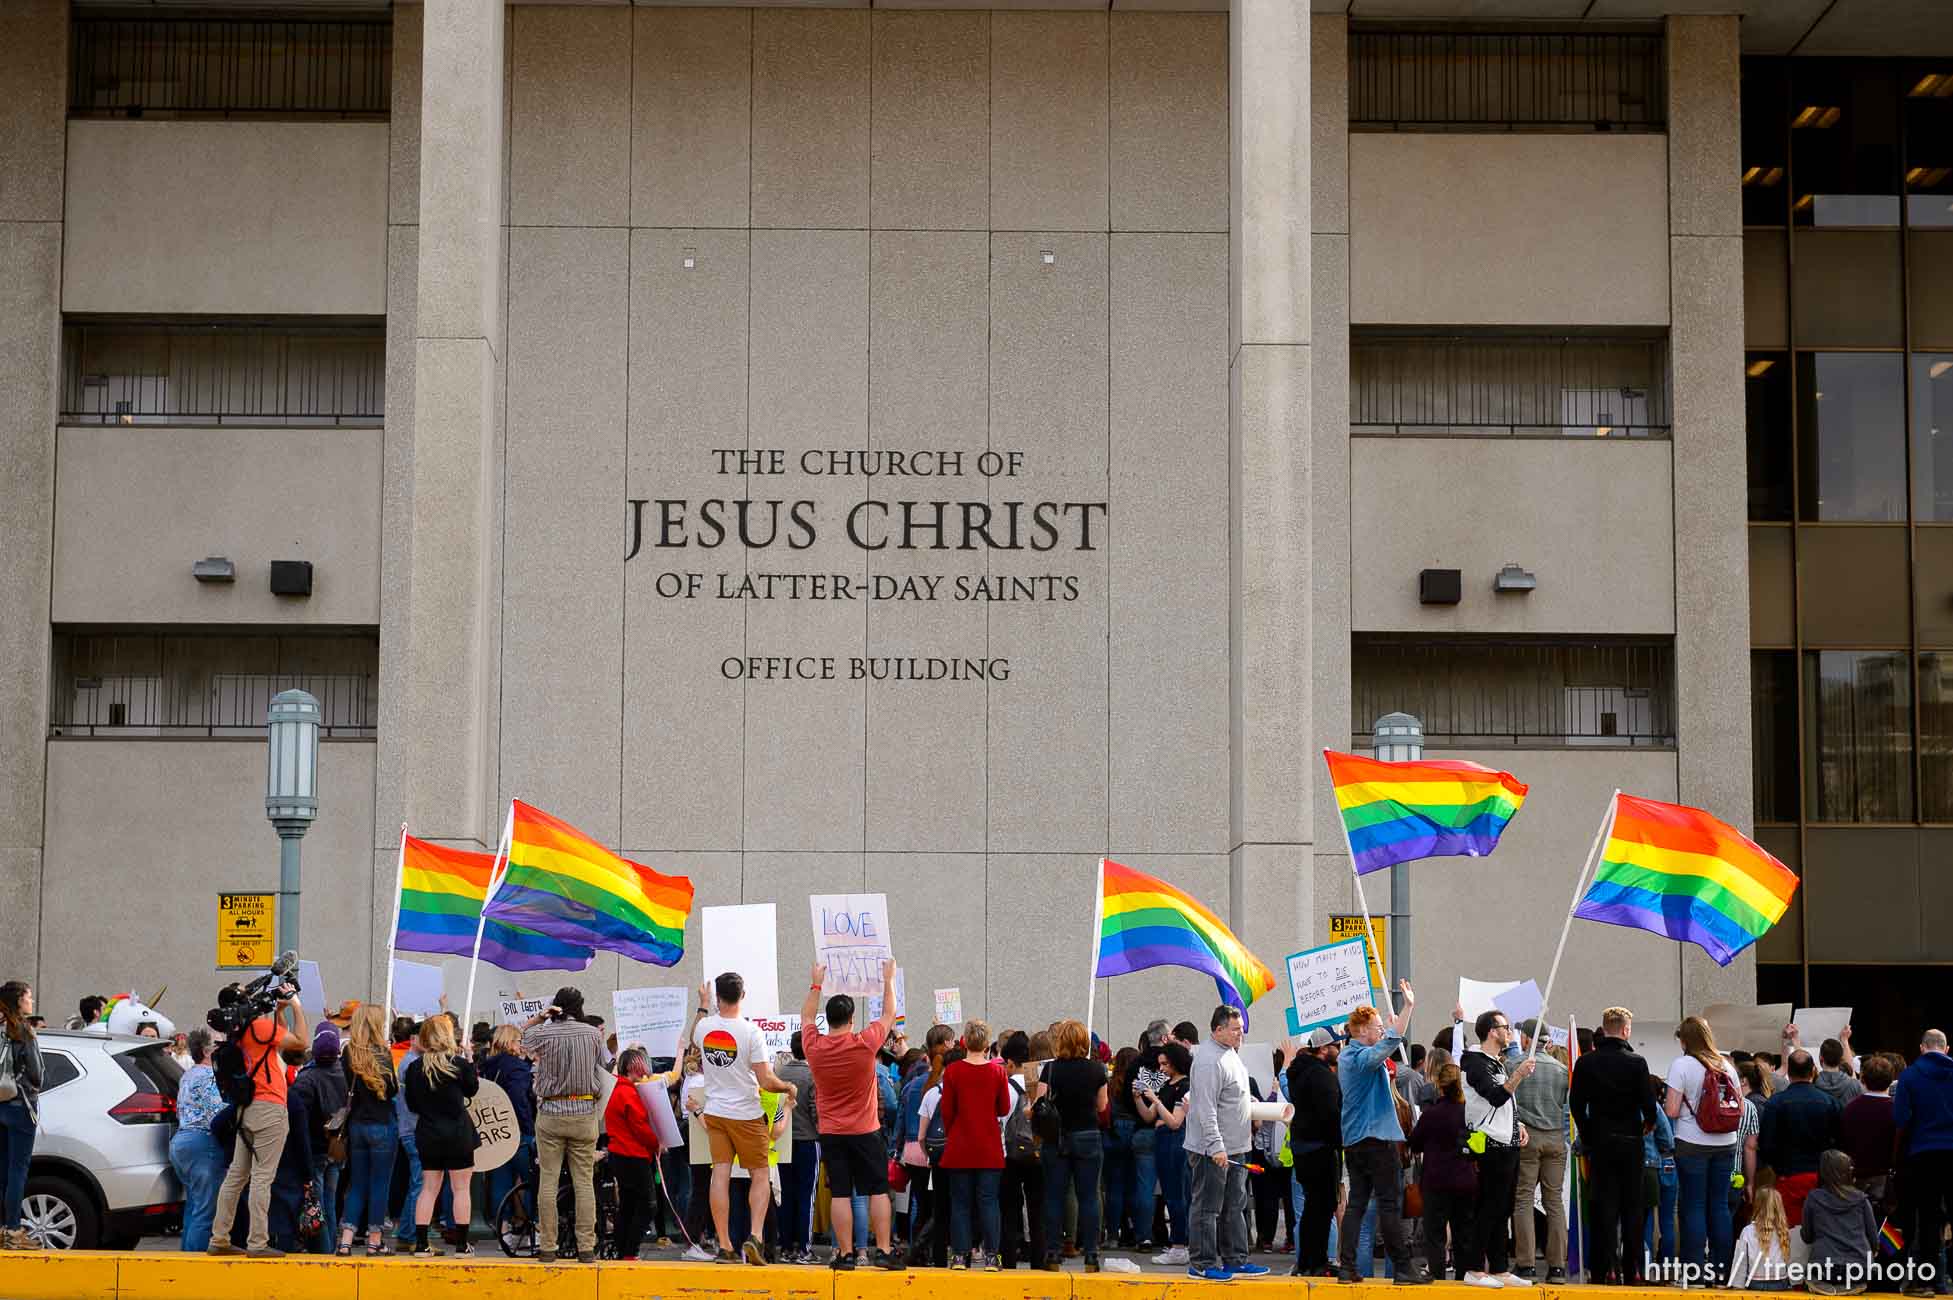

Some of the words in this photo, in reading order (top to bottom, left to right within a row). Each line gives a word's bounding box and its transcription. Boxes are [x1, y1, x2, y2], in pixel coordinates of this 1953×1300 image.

[711, 449, 786, 475] THE
[800, 450, 964, 477] CHURCH
[977, 451, 1025, 477] OF
[625, 499, 818, 561] JESUS
[845, 501, 1108, 552] CHRIST
[655, 572, 704, 599] OF
[716, 573, 945, 601] LATTER-DAY
[954, 575, 1080, 601] SAINTS
[721, 656, 836, 681] OFFICE
[848, 657, 1011, 682] BUILDING
[223, 896, 230, 909] 3
[822, 908, 877, 937] LOVE
[1334, 919, 1341, 930] 3
[826, 953, 889, 985] HATE
[1294, 959, 1310, 972] HOW
[1315, 951, 1337, 963] MANY
[1343, 945, 1362, 957] KIDS
[1297, 976, 1313, 991] HAVE
[1316, 969, 1328, 980] TO
[1336, 966, 1349, 978] DIE
[503, 1002, 518, 1015] BYU
[1300, 988, 1326, 1004] BEFORE
[752, 1018, 786, 1032] Jesus
[790, 1017, 802, 1031] ha
[816, 1015, 825, 1031] 2
[480, 1126, 512, 1145] ARS
